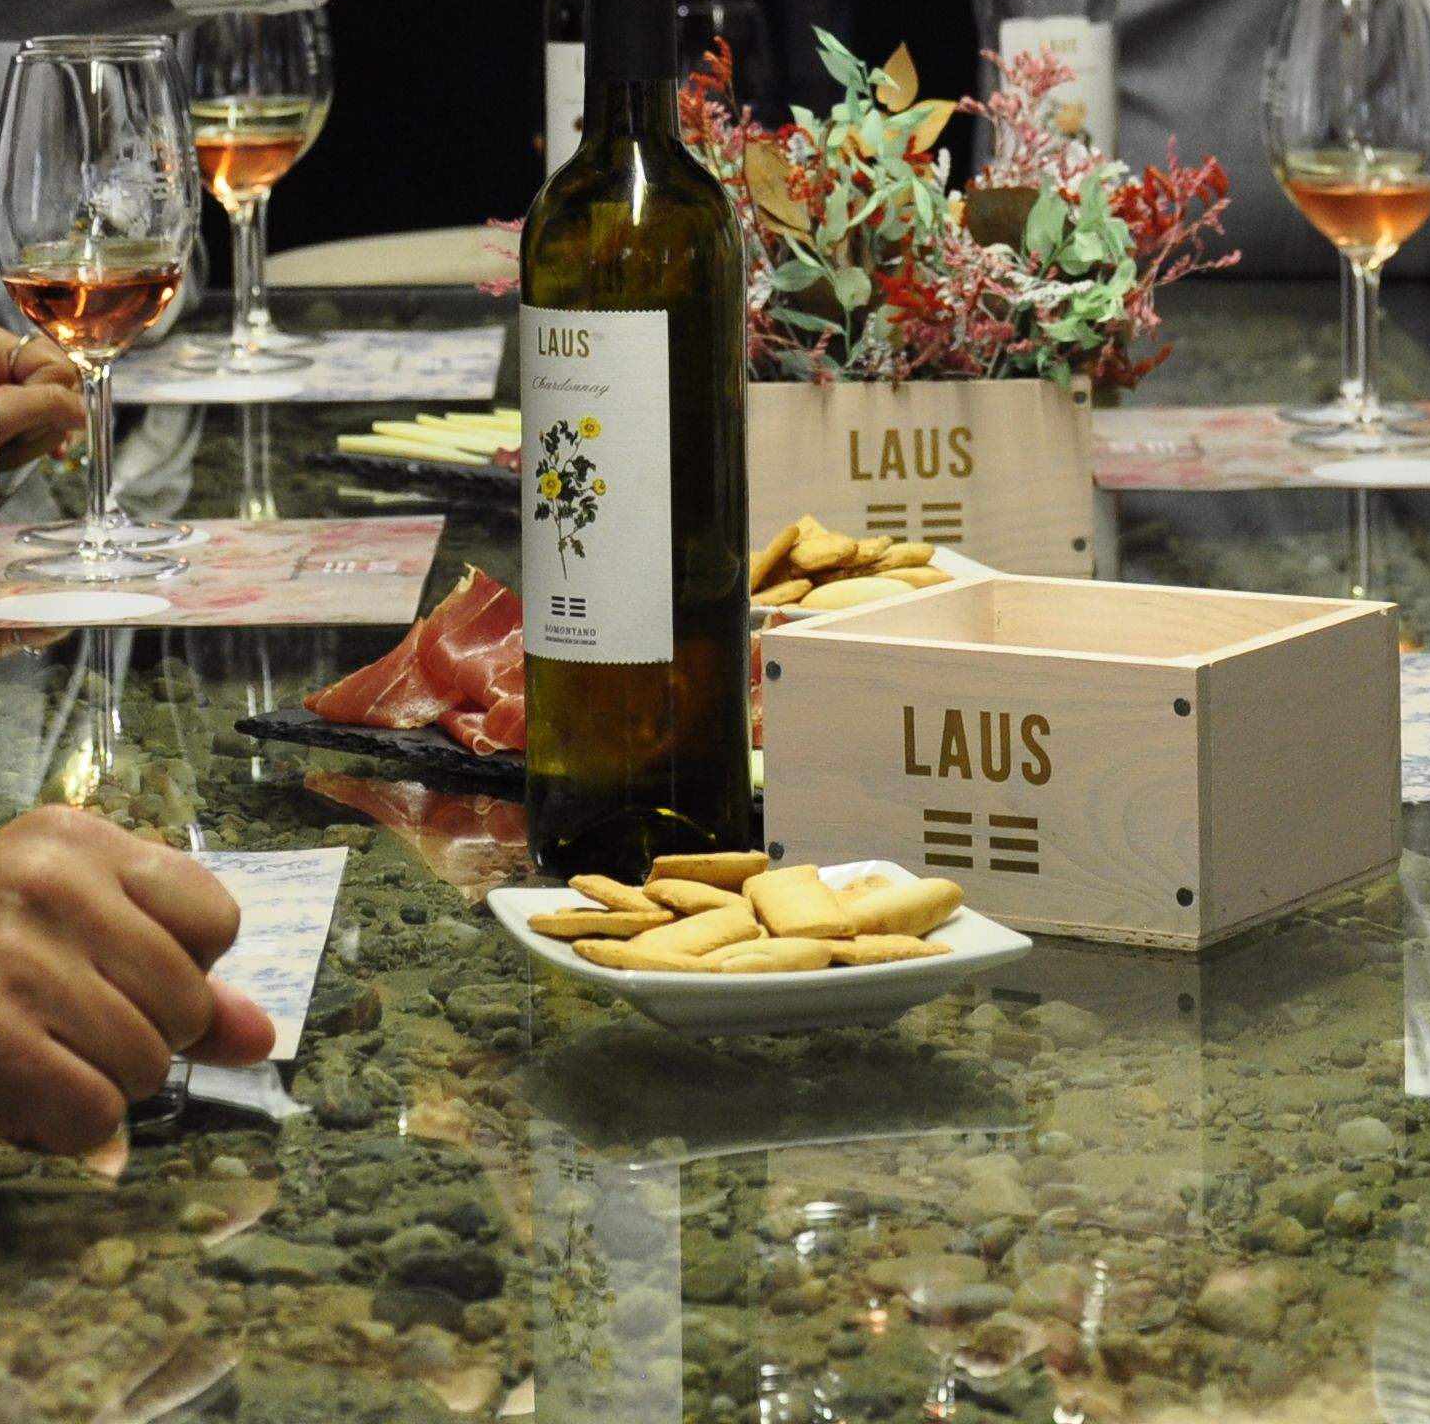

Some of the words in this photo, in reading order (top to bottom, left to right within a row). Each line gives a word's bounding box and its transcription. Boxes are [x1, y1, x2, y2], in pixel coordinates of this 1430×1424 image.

[538, 327, 590, 358] LAUS
[532, 375, 611, 398] Chardonnay
[849, 427, 973, 481] LAUS
[903, 705, 1052, 785] LAUS
